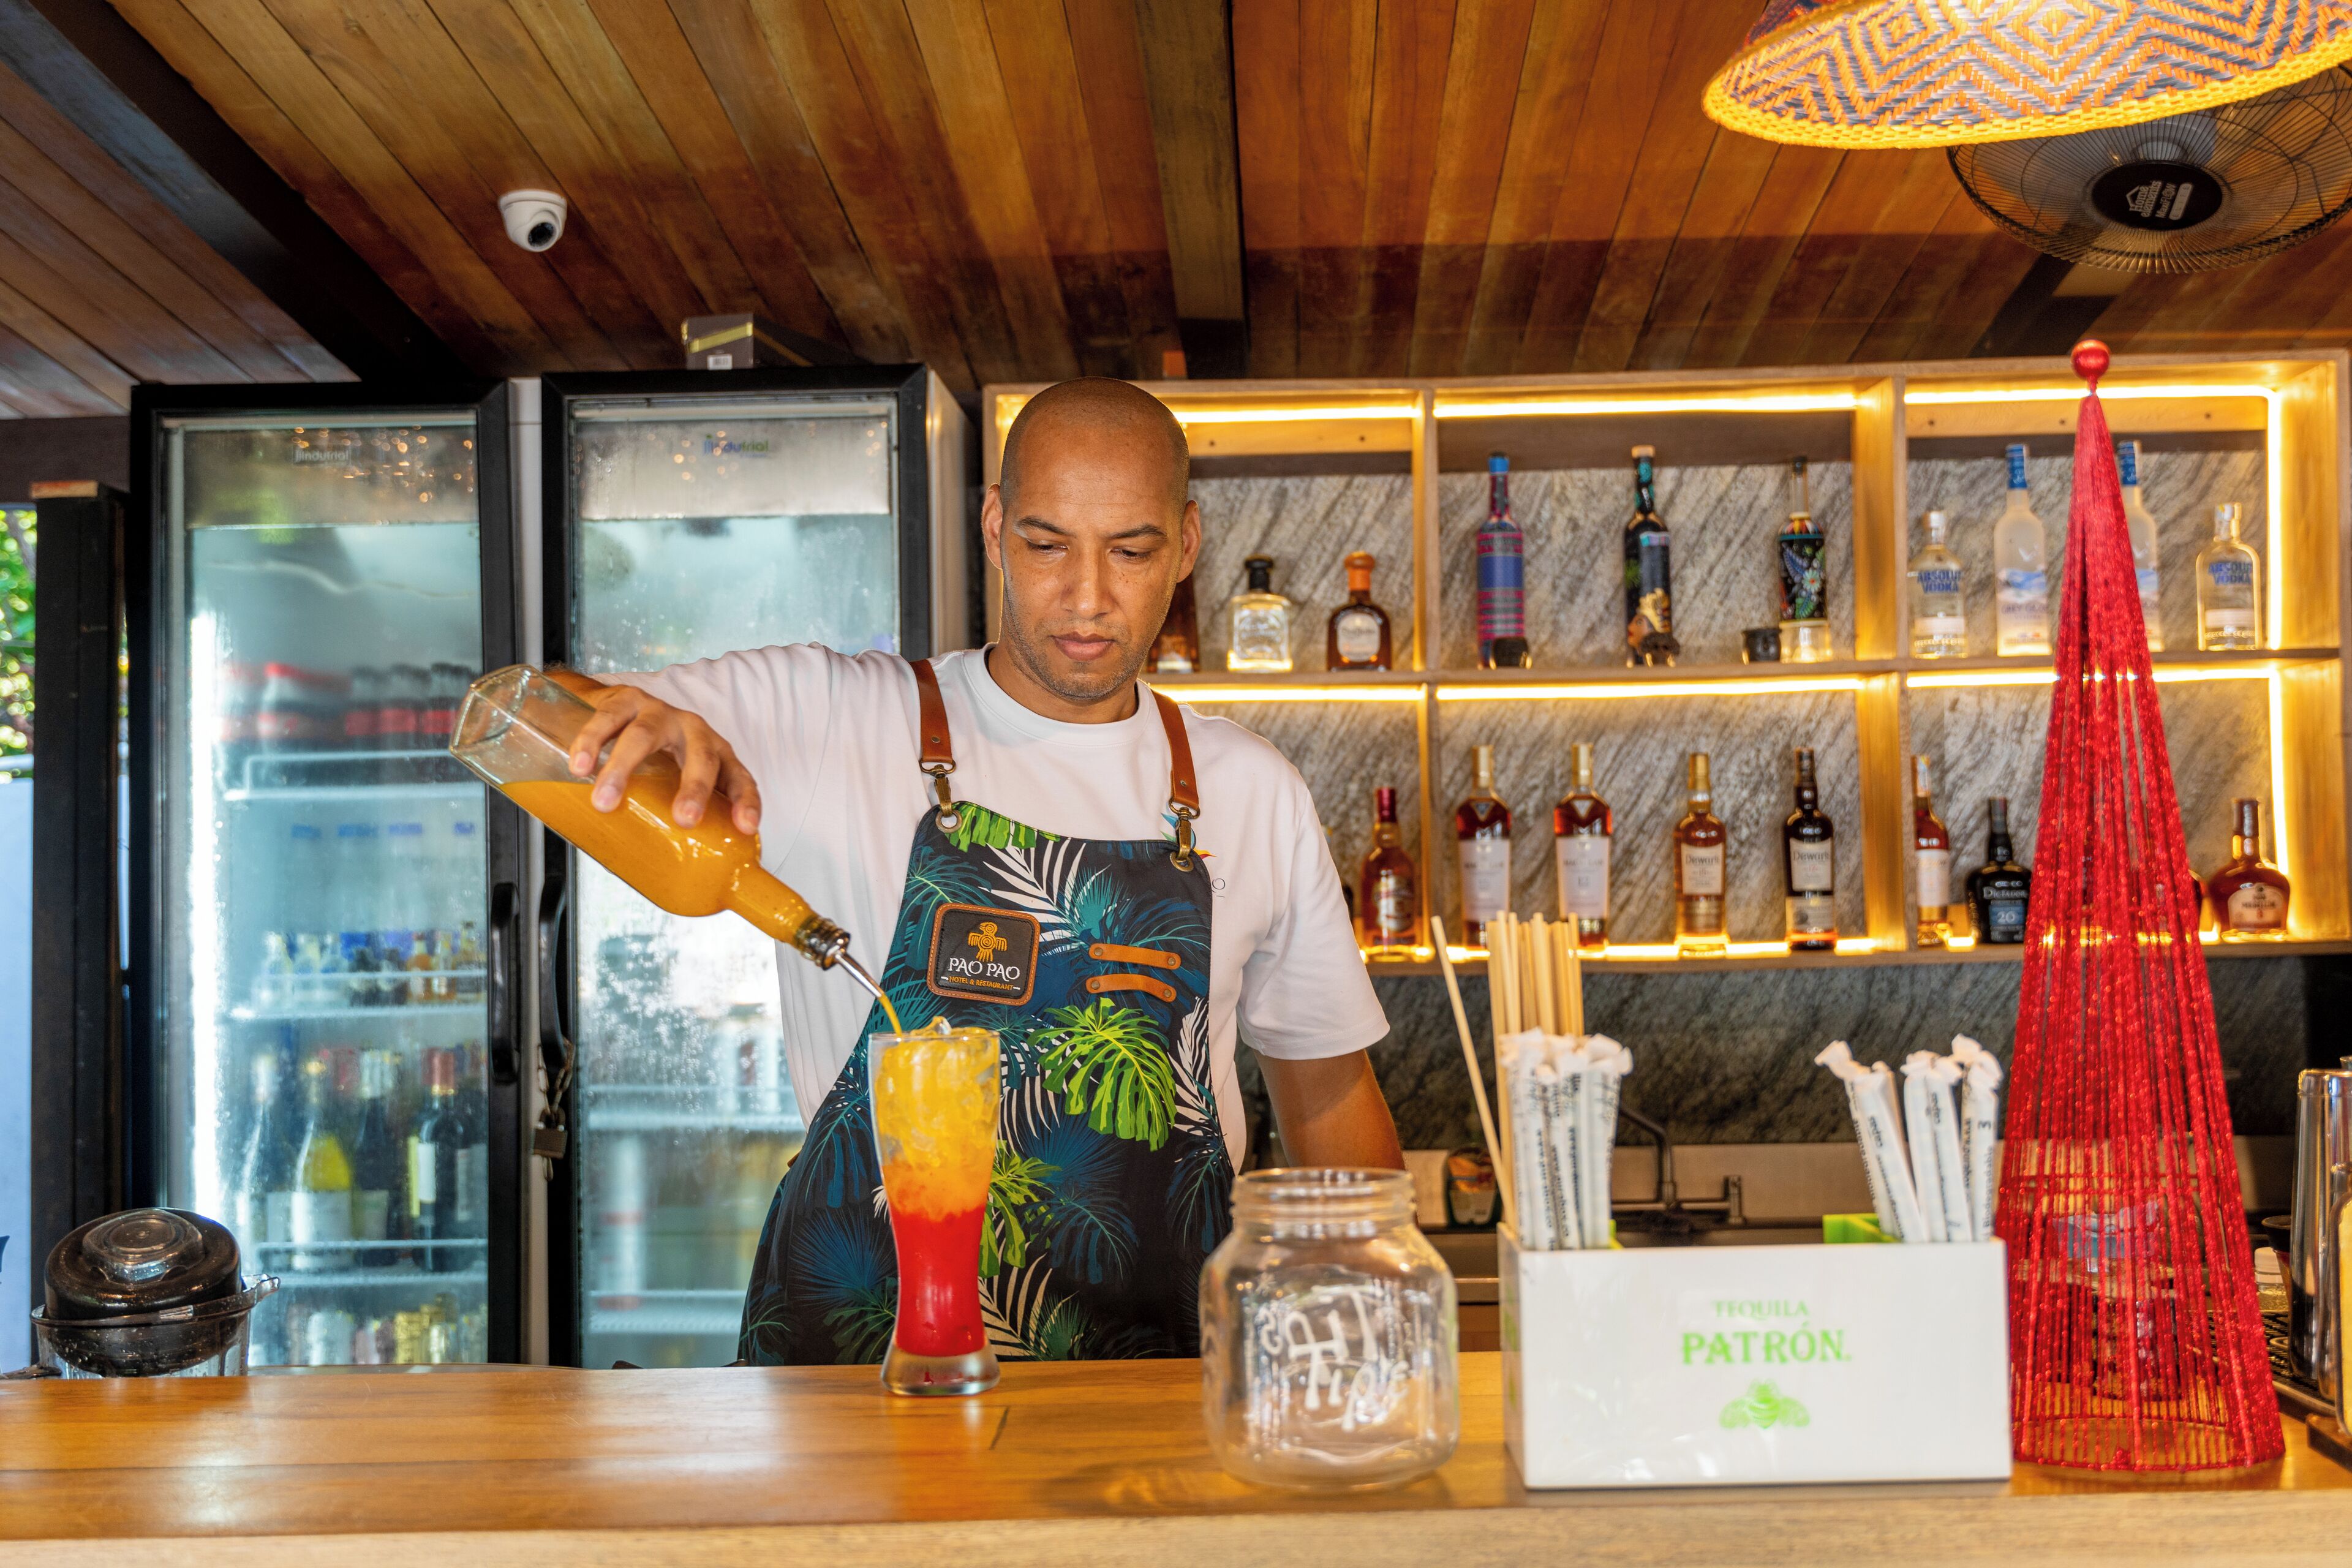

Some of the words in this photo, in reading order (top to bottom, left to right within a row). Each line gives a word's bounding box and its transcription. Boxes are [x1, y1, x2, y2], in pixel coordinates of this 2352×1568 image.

[2128, 184, 2149, 213] Home
[1996, 910, 2018, 925] 20
[948, 957, 982, 976] PAO
[986, 963, 1020, 982] PAO
[949, 976, 968, 984] HOTEL
[976, 979, 1014, 990] RESTAURANT
[1978, 1121, 1992, 1131] 3
[1712, 1300, 1811, 1321] TEQUILA
